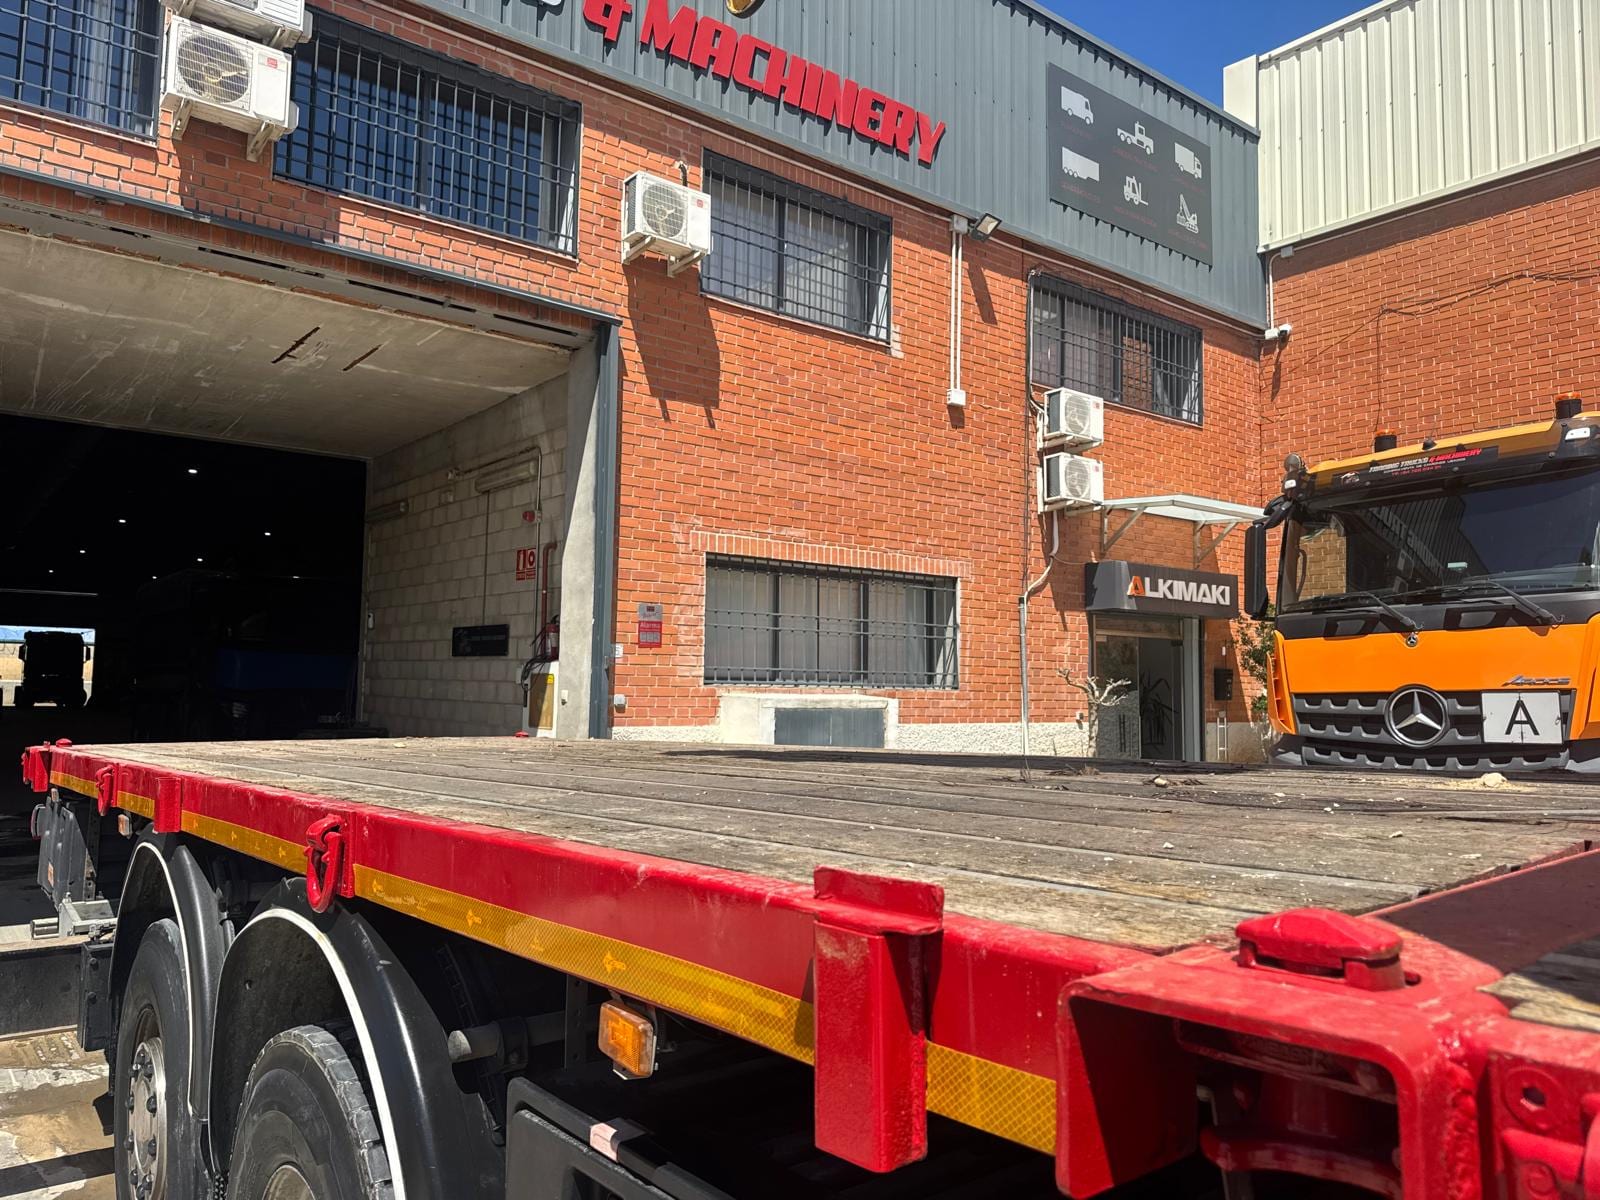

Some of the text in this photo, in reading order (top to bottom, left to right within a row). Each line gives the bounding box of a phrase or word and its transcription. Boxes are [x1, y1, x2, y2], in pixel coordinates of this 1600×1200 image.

[639, 0, 946, 164] MACHINERY
[1127, 575, 1230, 605] ALKIMAKI
[1505, 699, 1540, 735] A
